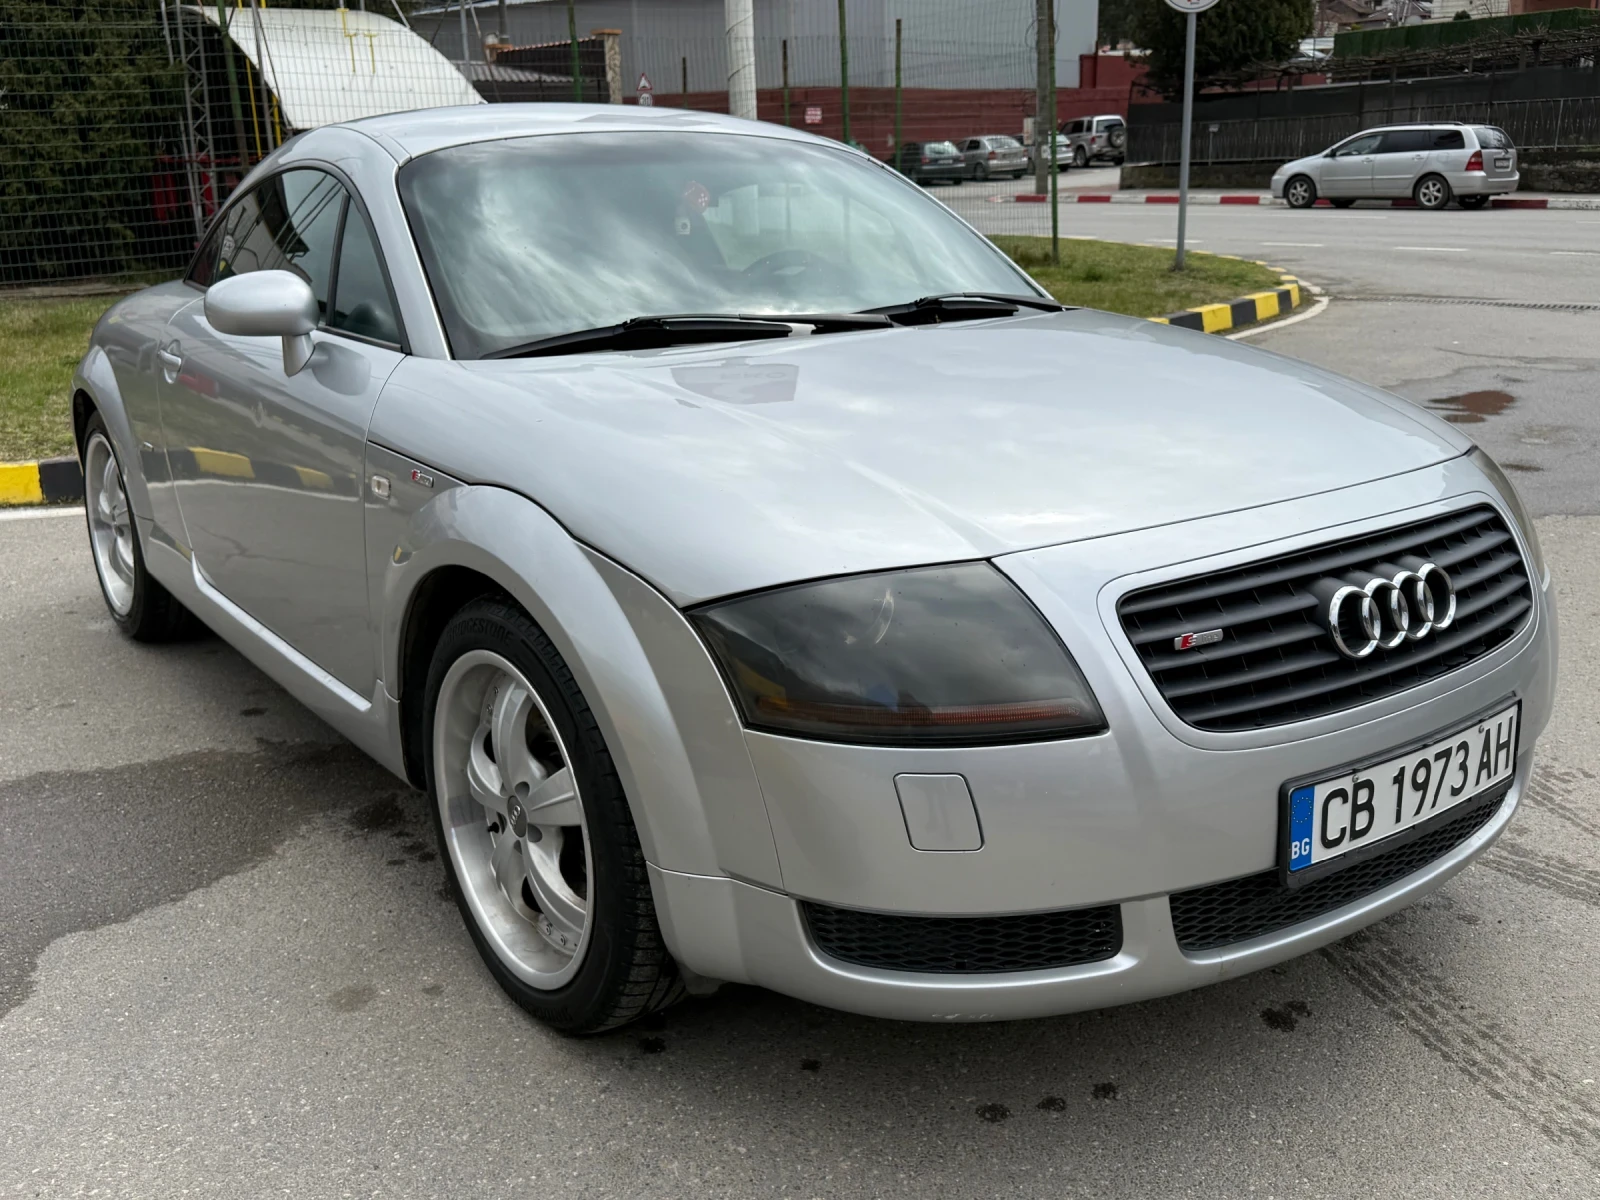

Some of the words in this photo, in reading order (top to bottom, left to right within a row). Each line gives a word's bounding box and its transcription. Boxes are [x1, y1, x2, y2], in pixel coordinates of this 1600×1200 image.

[1320, 778, 1375, 850] CB
[1392, 740, 1470, 825] 1973
[1475, 715, 1514, 787] AH
[1291, 837, 1310, 860] BG
